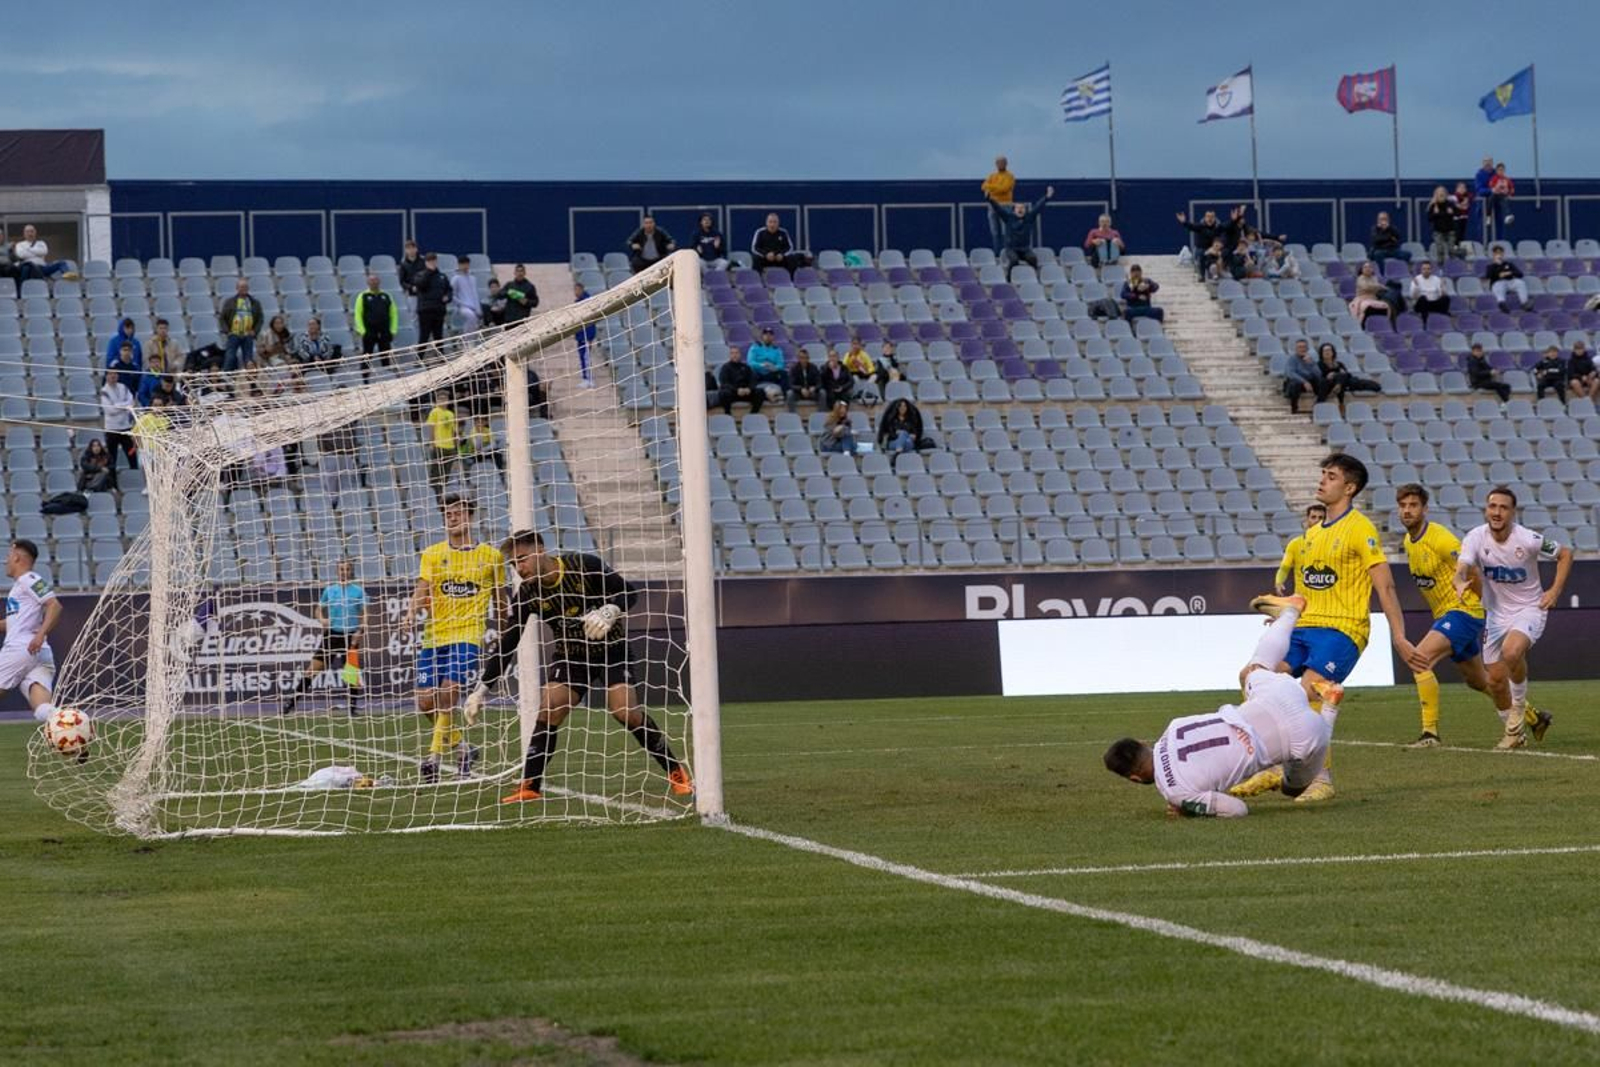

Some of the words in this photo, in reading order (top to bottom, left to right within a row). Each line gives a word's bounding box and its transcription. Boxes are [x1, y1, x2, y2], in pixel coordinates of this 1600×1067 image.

[200, 627, 322, 653] EuroTaller
[174, 671, 271, 692] ALLERES
[1176, 717, 1230, 763] 11
[1160, 753, 1177, 788] MARIO
